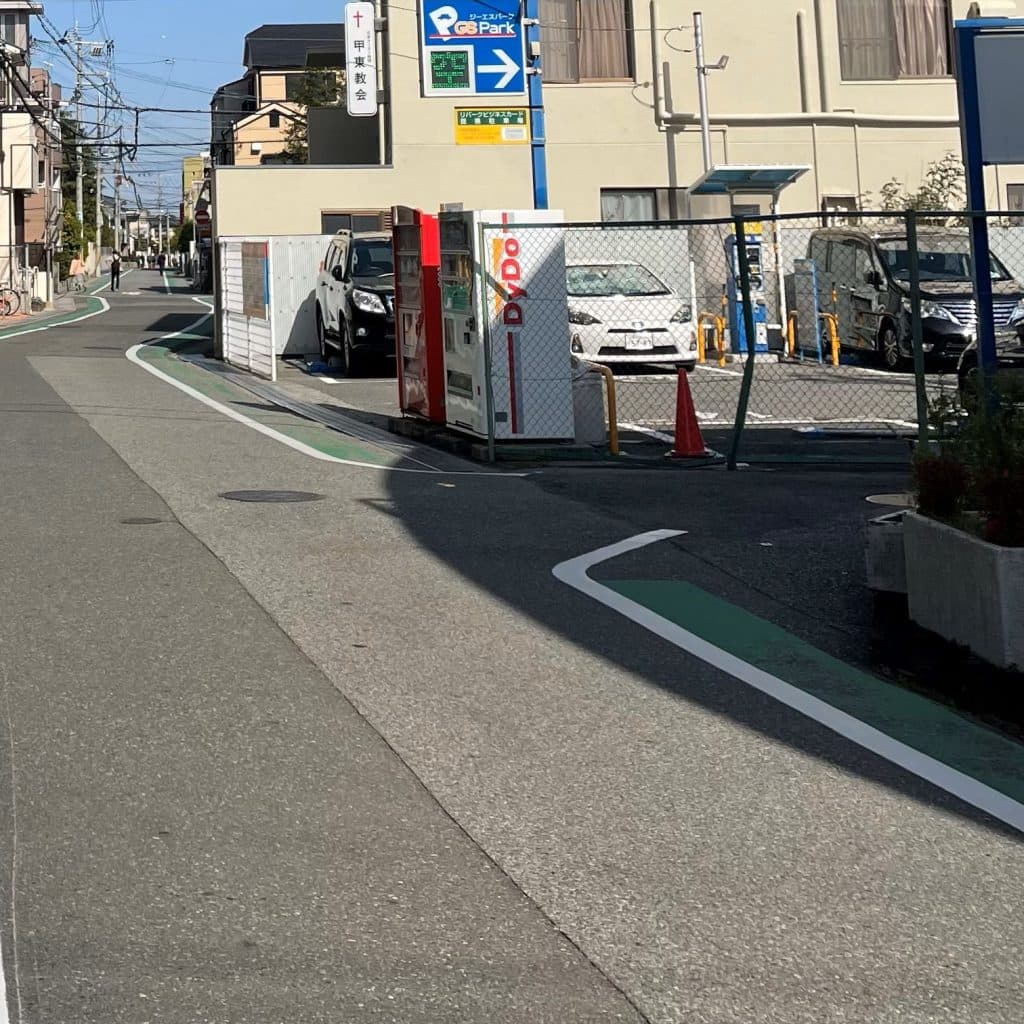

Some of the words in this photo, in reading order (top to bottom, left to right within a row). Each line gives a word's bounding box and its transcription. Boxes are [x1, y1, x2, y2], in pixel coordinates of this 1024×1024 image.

[479, 21, 516, 34] Park
[354, 40, 367, 101] 甲東教会
[501, 238, 527, 324] DyDo
